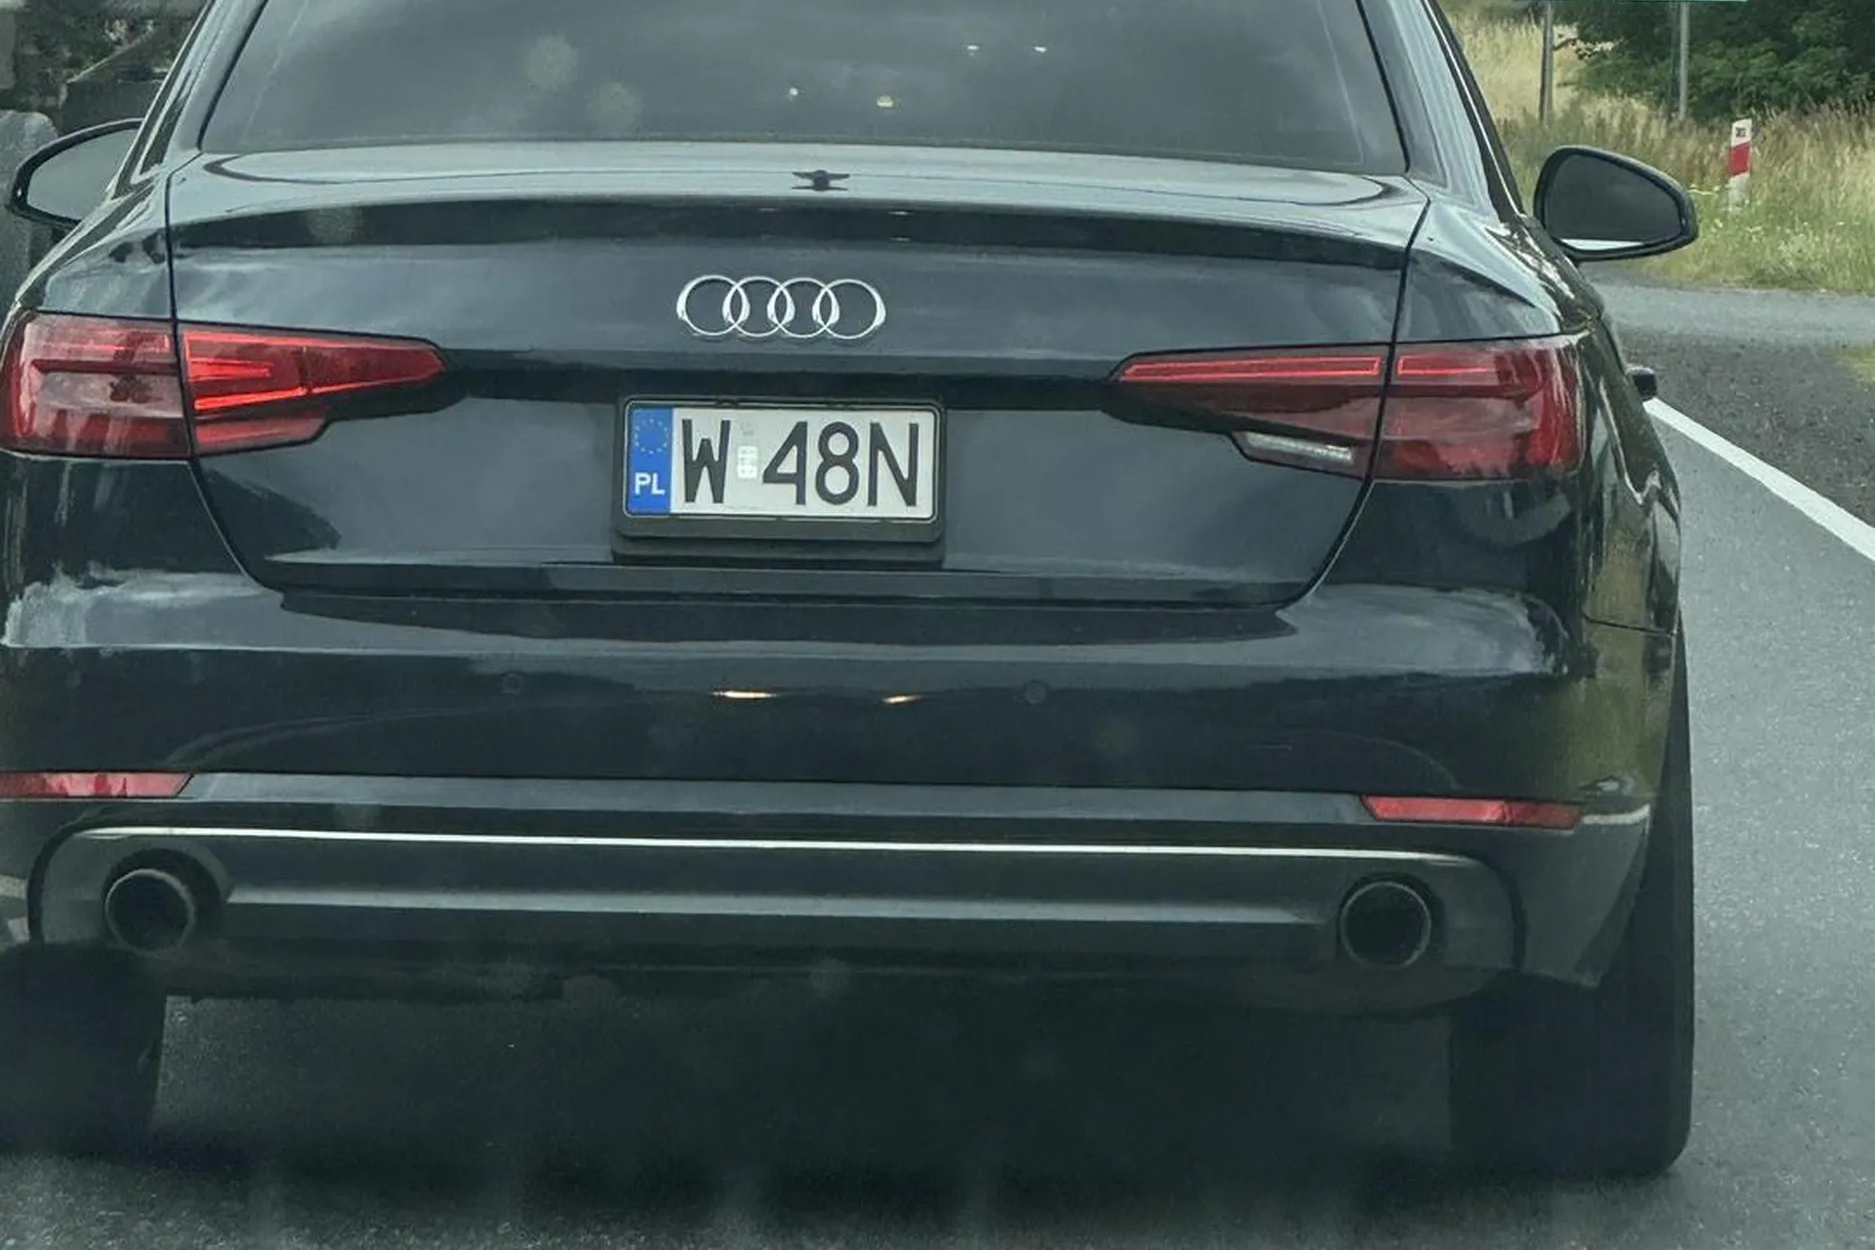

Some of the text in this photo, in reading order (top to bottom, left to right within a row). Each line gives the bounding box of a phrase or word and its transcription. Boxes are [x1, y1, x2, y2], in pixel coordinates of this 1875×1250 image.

[634, 472, 665, 495] PL
[681, 418, 919, 507] W 48N
